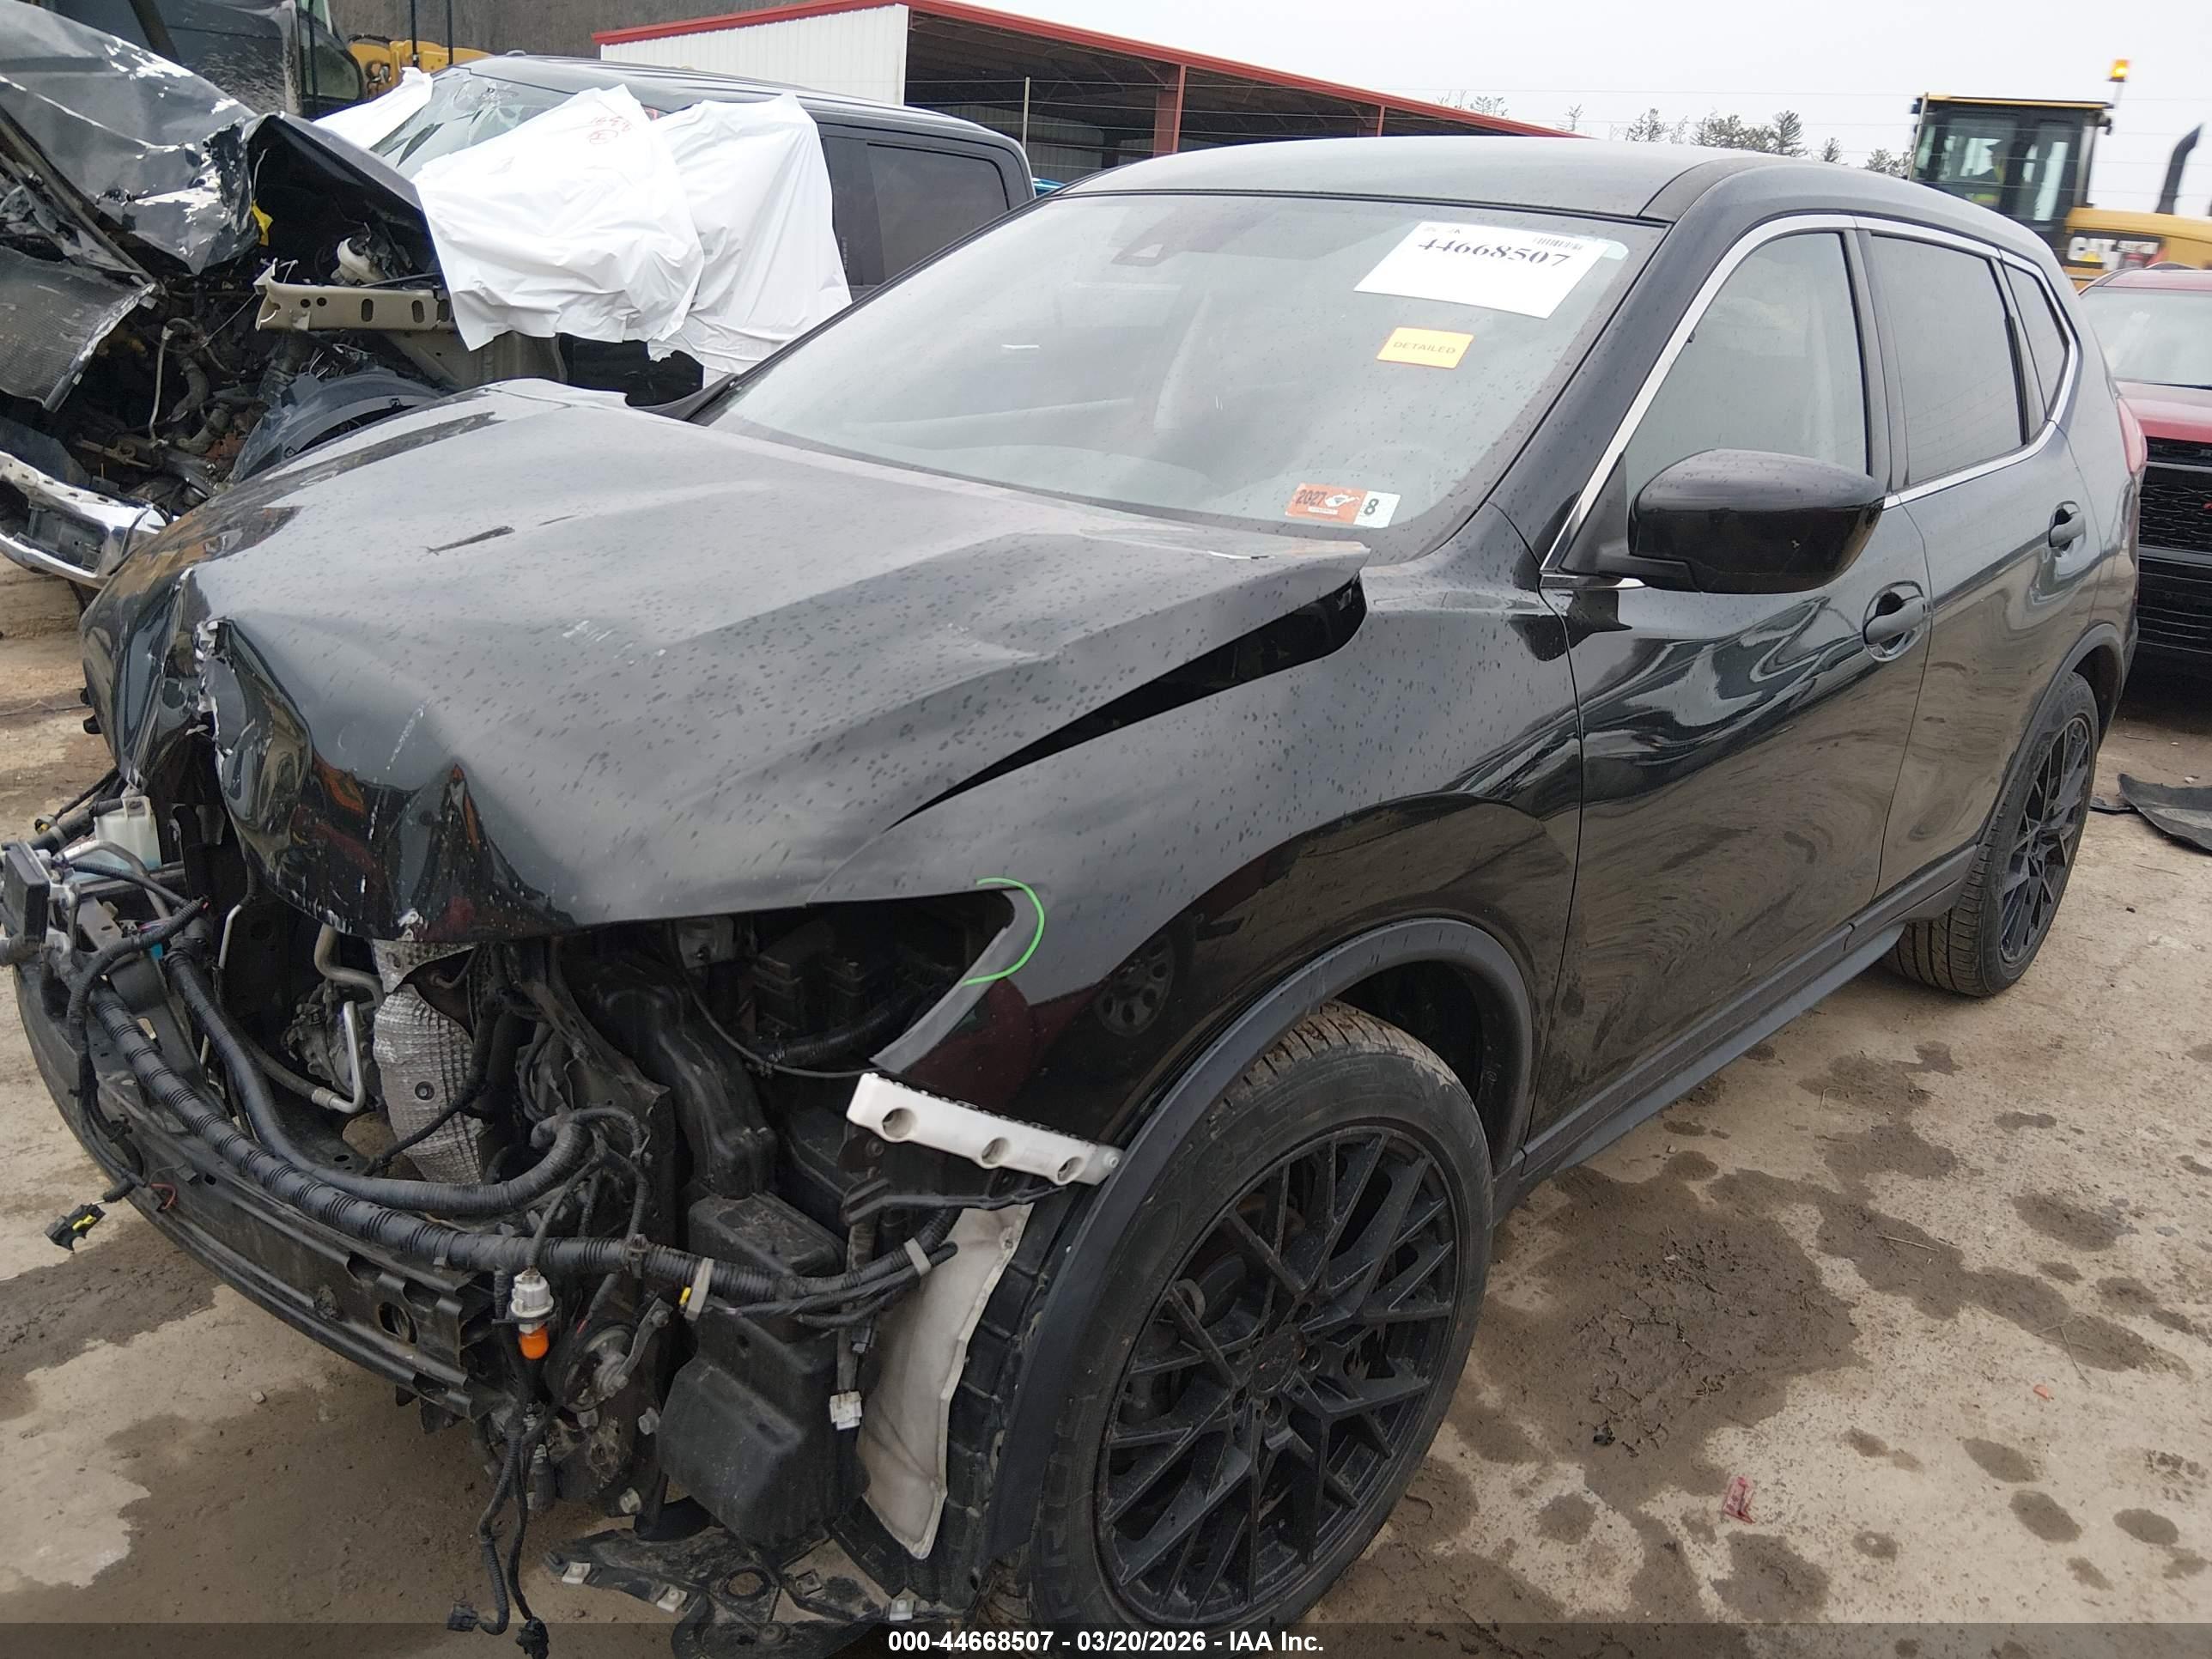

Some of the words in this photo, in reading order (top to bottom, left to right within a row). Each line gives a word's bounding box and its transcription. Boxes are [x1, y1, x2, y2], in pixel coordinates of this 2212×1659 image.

[1418, 238, 1571, 267] 44668507
[1393, 341, 1456, 355] DETAILED
[1296, 489, 1328, 506] 2027
[1364, 498, 1379, 516] 8
